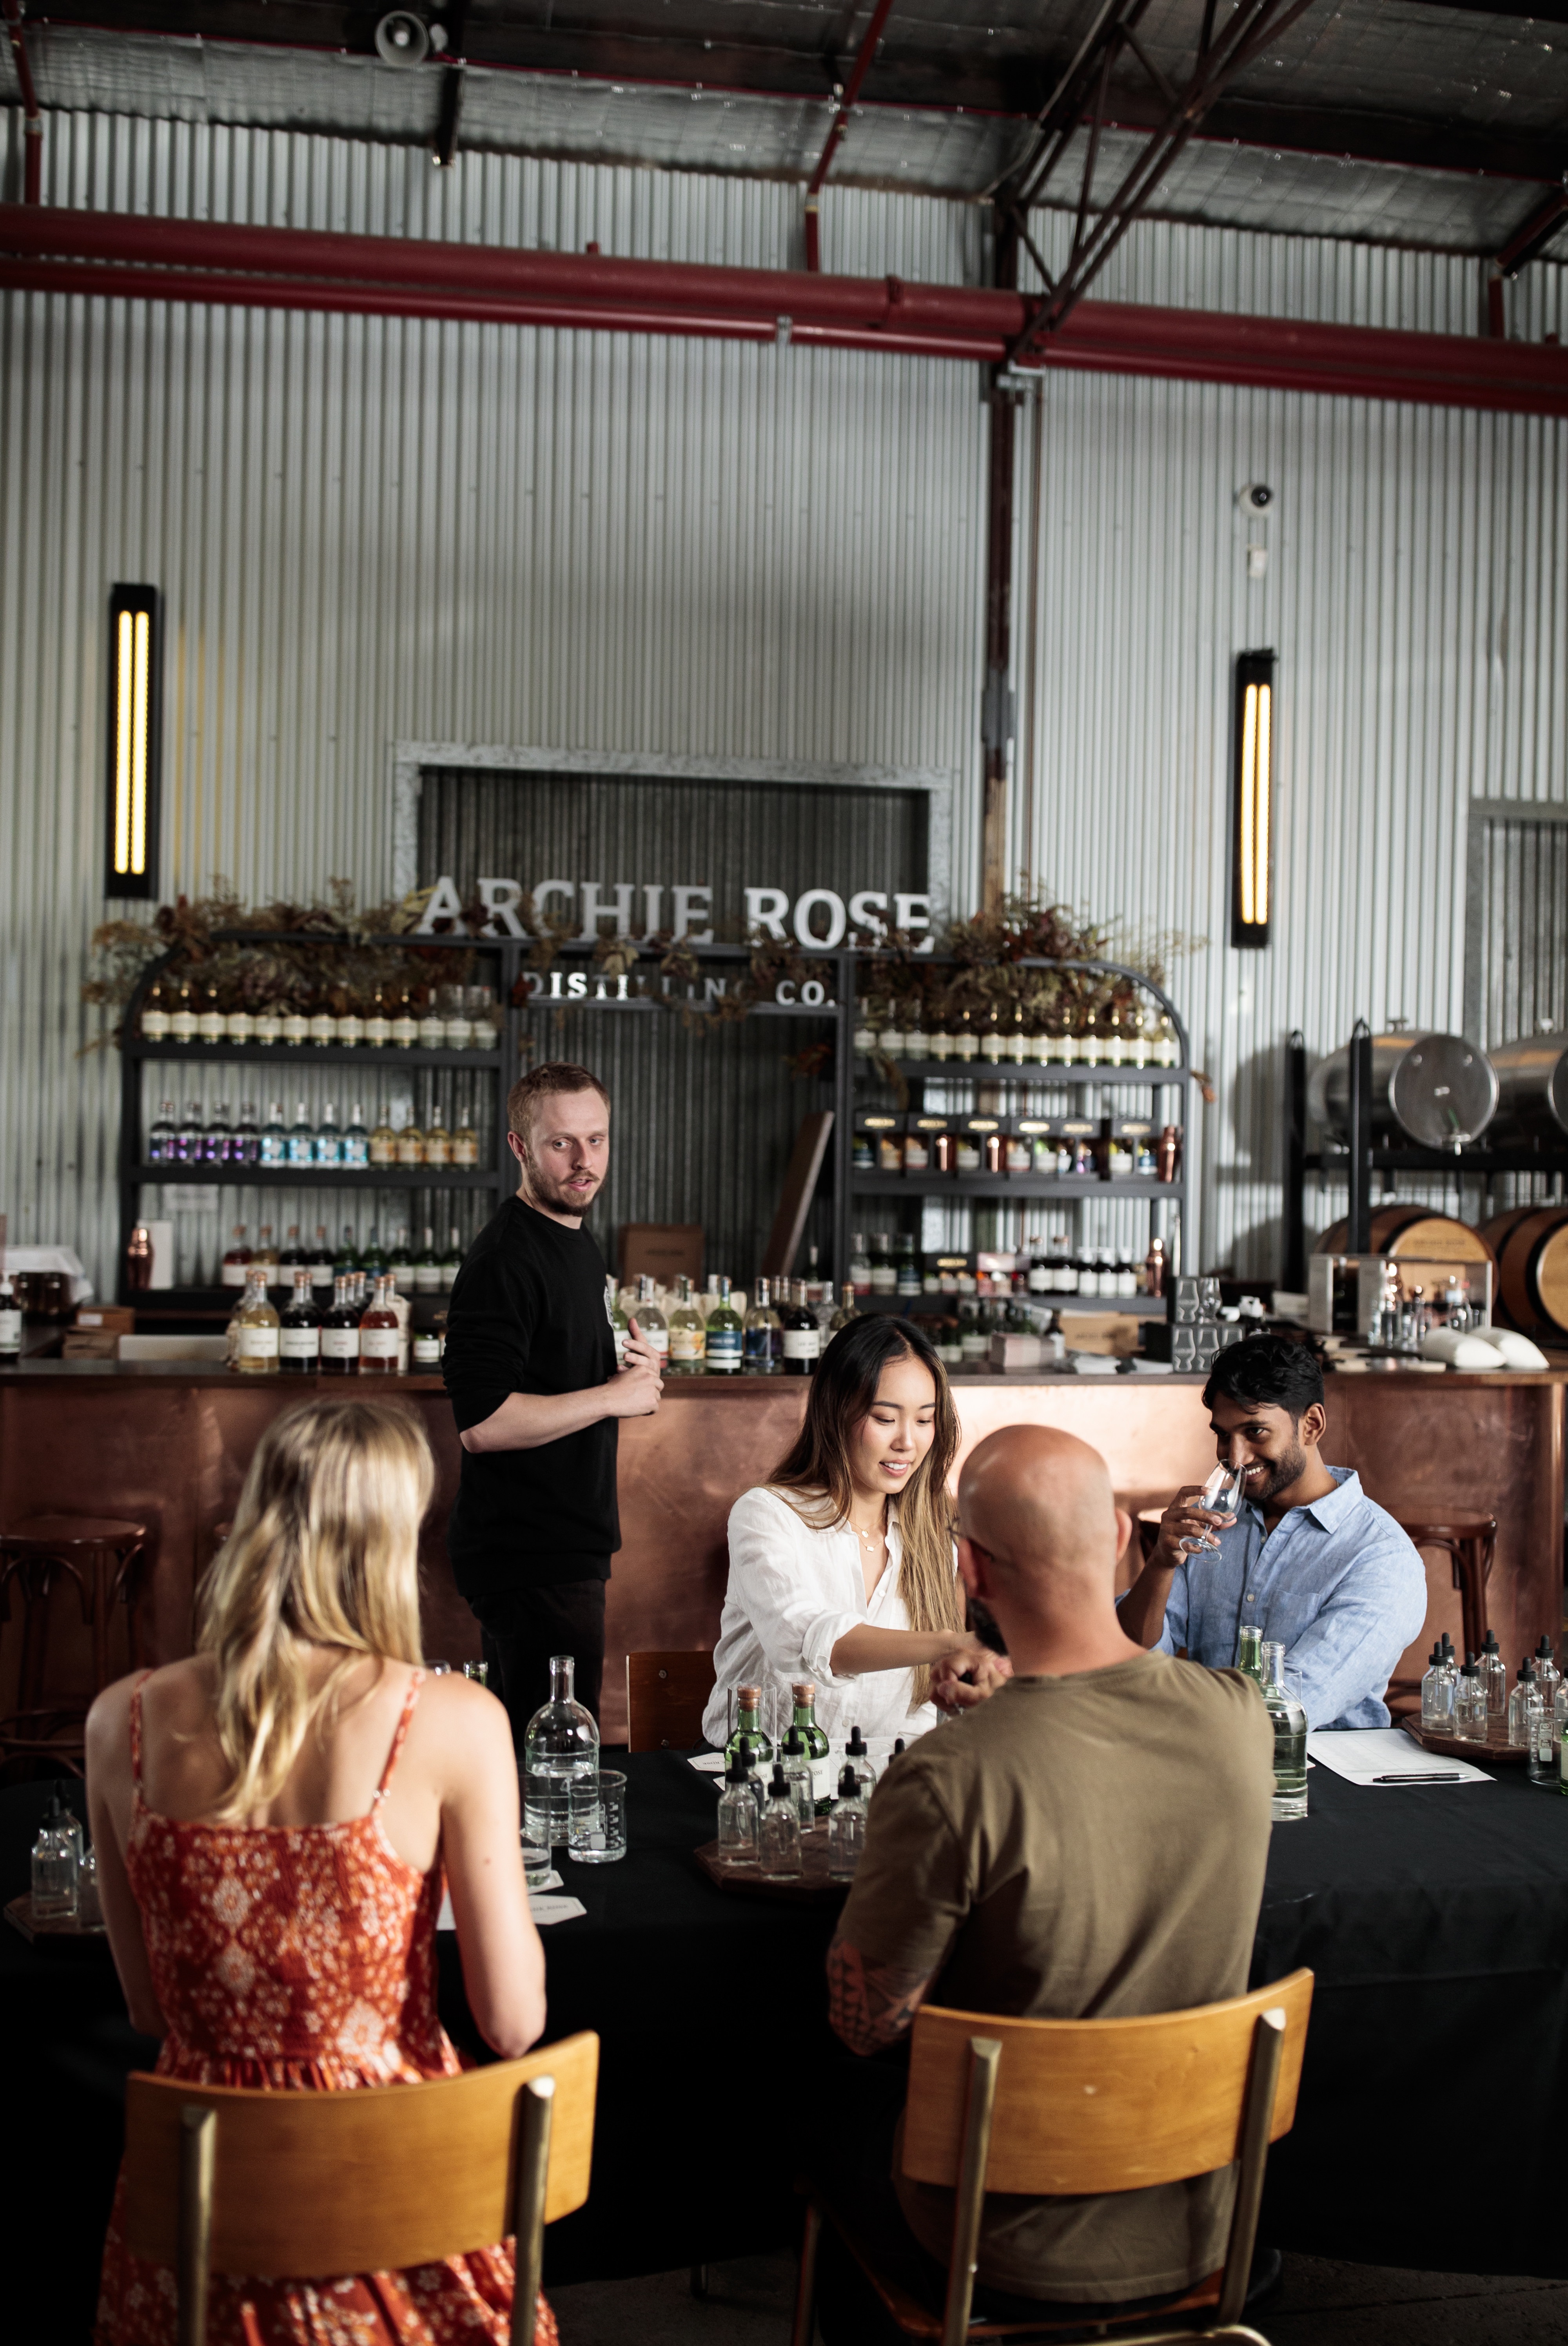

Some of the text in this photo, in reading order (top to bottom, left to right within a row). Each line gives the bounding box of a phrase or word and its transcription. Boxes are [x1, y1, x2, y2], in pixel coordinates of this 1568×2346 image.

[416, 876, 935, 954] ARCHIE ROSE
[776, 980, 836, 1006] CO.
